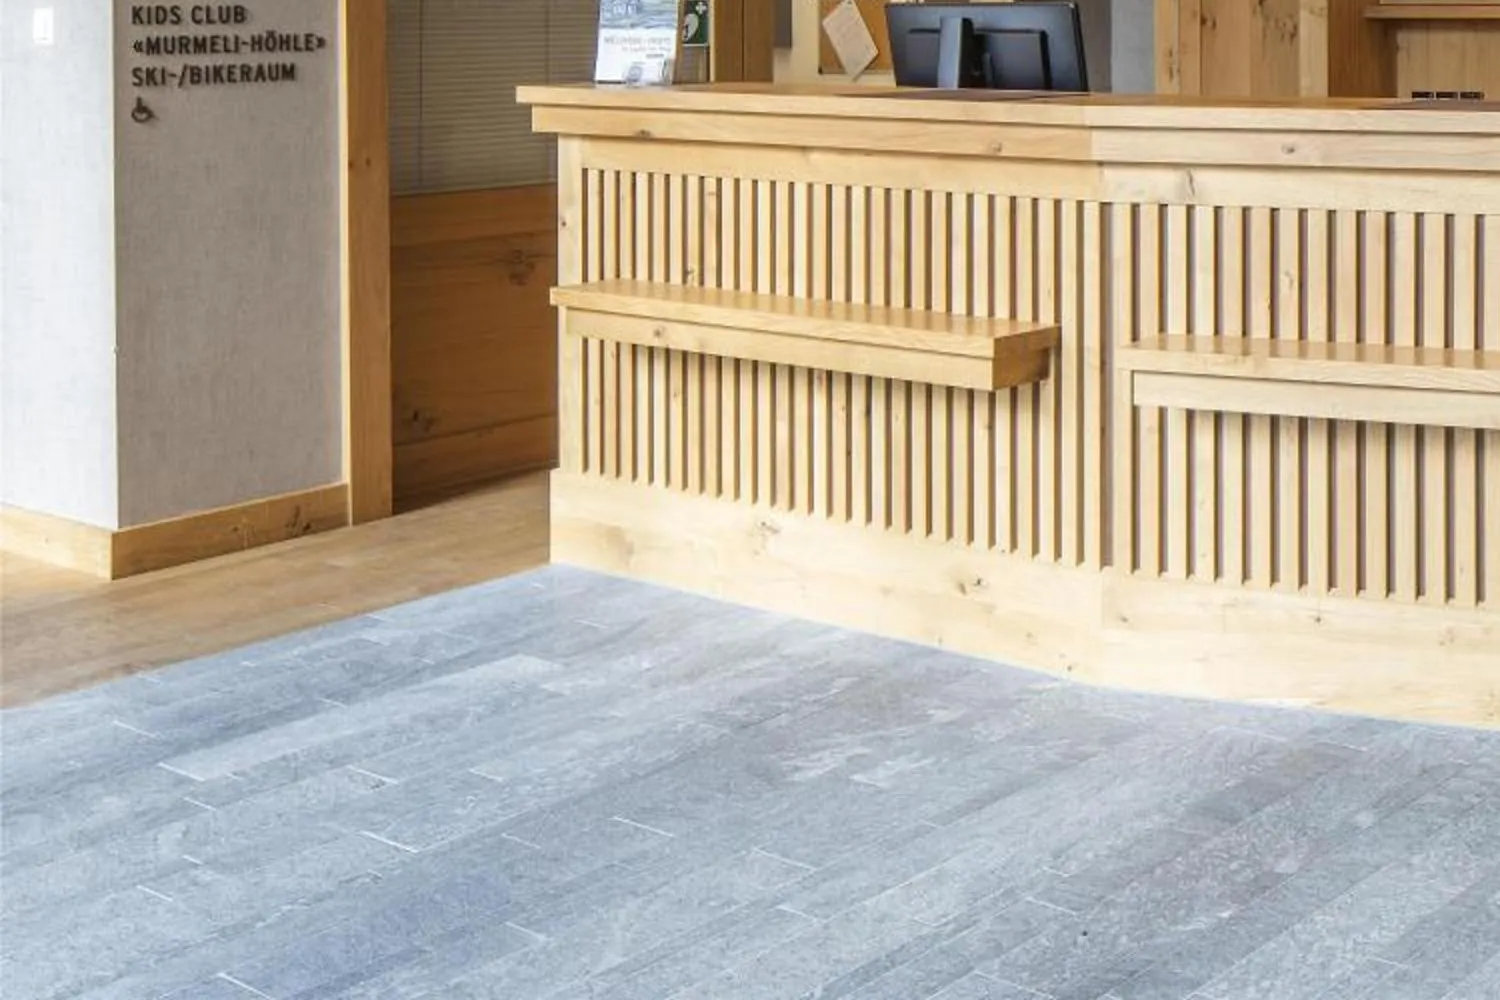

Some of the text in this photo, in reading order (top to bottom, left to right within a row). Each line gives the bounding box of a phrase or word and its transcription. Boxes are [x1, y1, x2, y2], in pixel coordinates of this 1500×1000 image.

[131, 4, 248, 25] KIDS CLUB
[131, 62, 297, 88] SKI-/BIKERAUM
